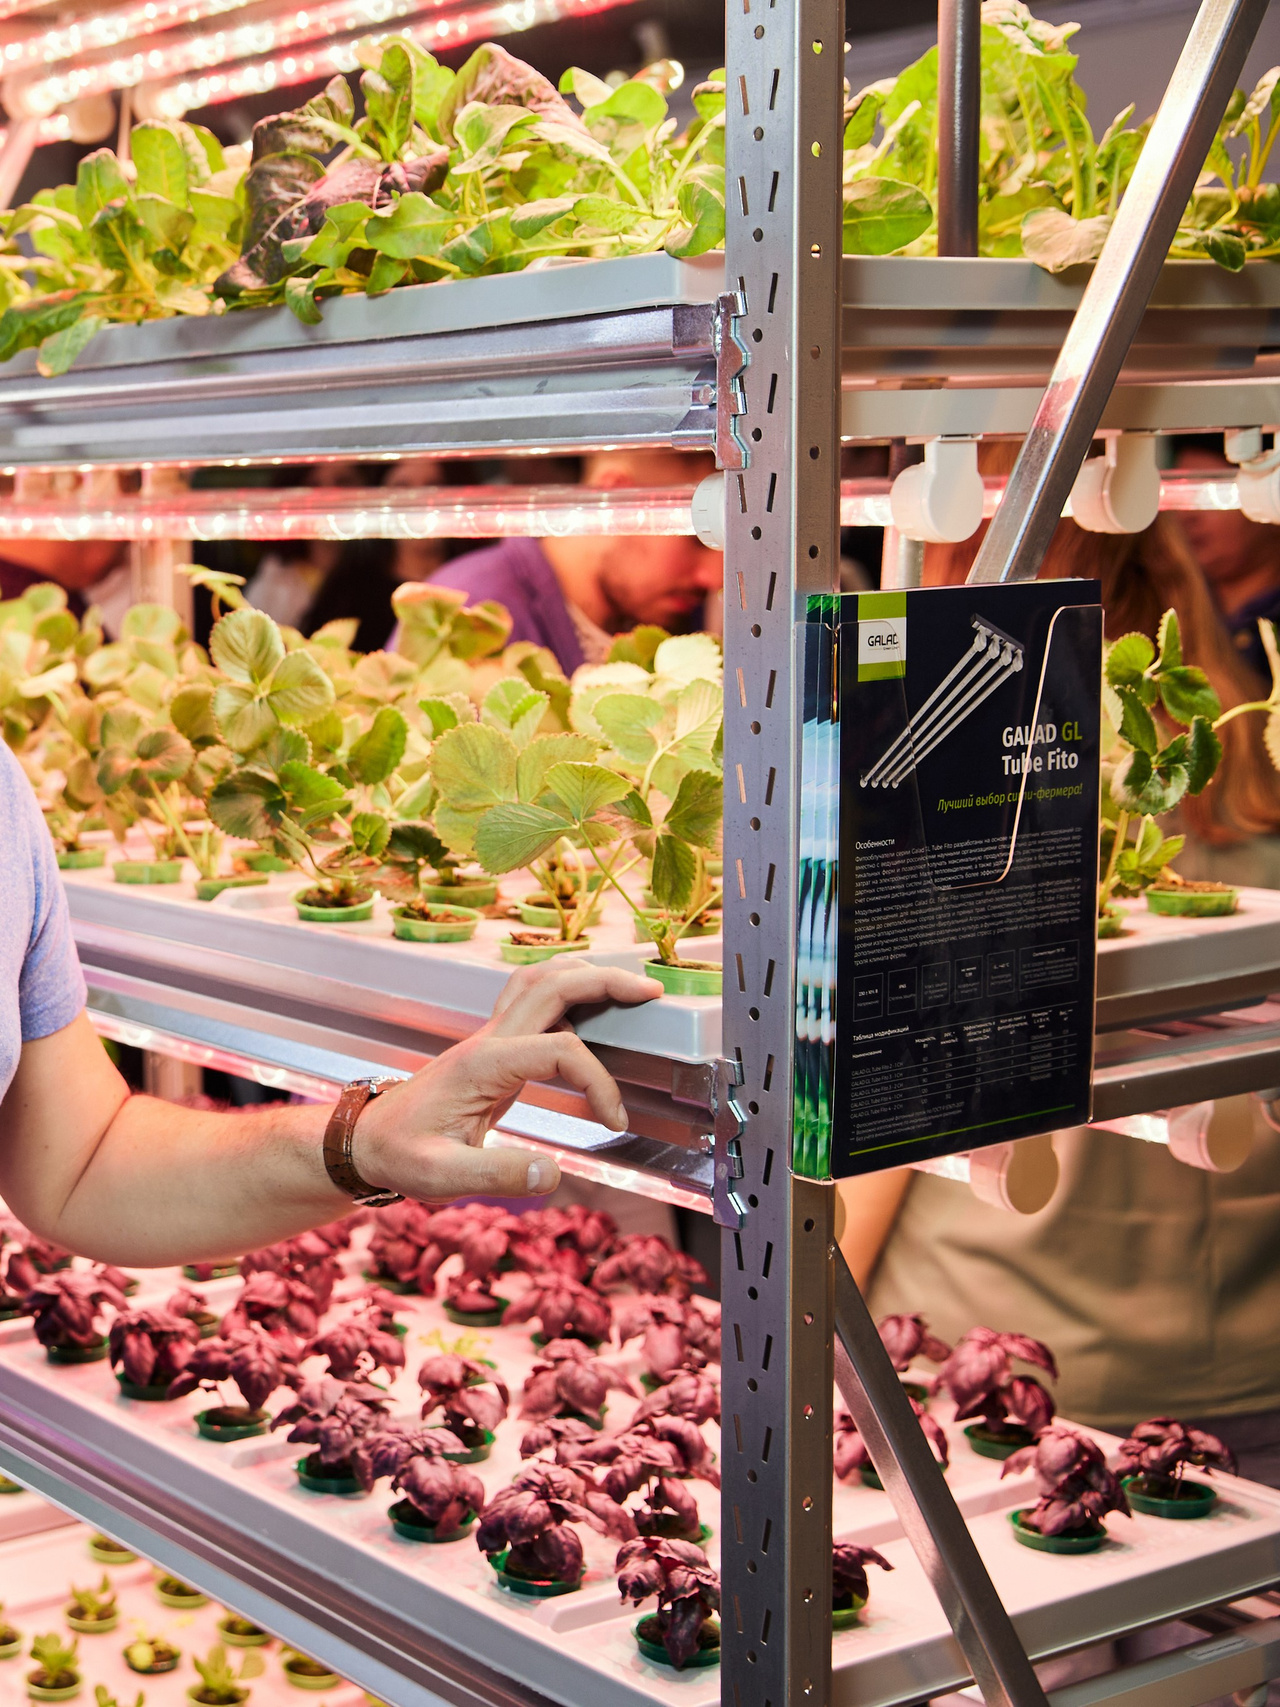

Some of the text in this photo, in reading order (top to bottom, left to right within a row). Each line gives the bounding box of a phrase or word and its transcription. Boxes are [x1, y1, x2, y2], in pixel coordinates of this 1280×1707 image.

[1002, 721, 1083, 748] GALAD GL
[1002, 747, 1079, 775] Tube Fito
[937, 794, 974, 814] Лучший
[976, 791, 1005, 806] выбор
[855, 838, 895, 850] Особенности
[852, 1024, 909, 1041] Таблица модификаций
